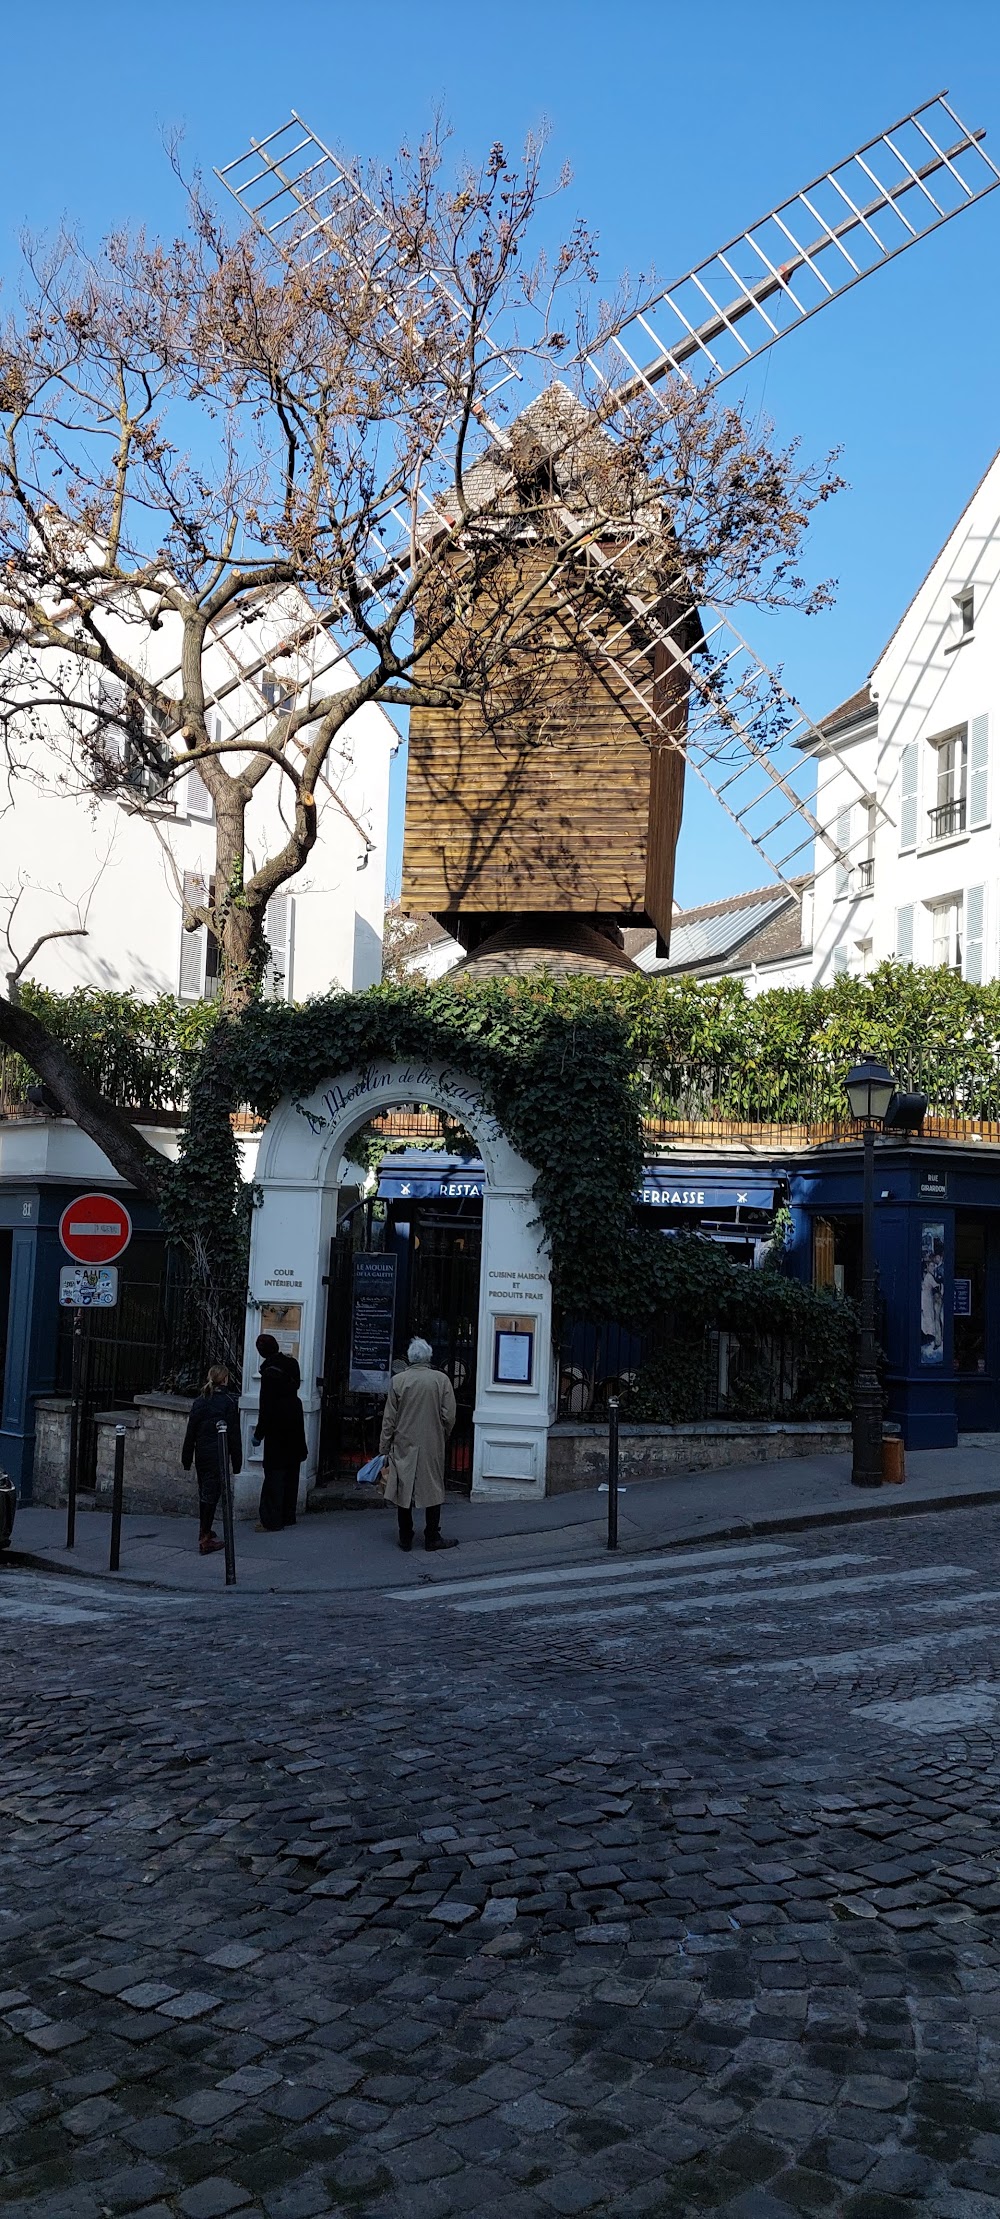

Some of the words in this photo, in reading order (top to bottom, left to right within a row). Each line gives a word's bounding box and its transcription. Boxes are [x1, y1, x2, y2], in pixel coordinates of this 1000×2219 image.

[321, 1064, 395, 1117] Moulin
[398, 1066, 414, 1083] de
[927, 1174, 939, 1182] RUE
[920, 1184, 946, 1193] GIRARDON
[356, 1263, 364, 1271] LE
[365, 1264, 394, 1272] MOULIN
[488, 1271, 516, 1279] CUISINE
[517, 1272, 546, 1280] MAISON
[264, 1279, 303, 1288] INTÉRIEURE
[488, 1290, 523, 1299] PRODUITS
[524, 1292, 544, 1300] FRAIS
